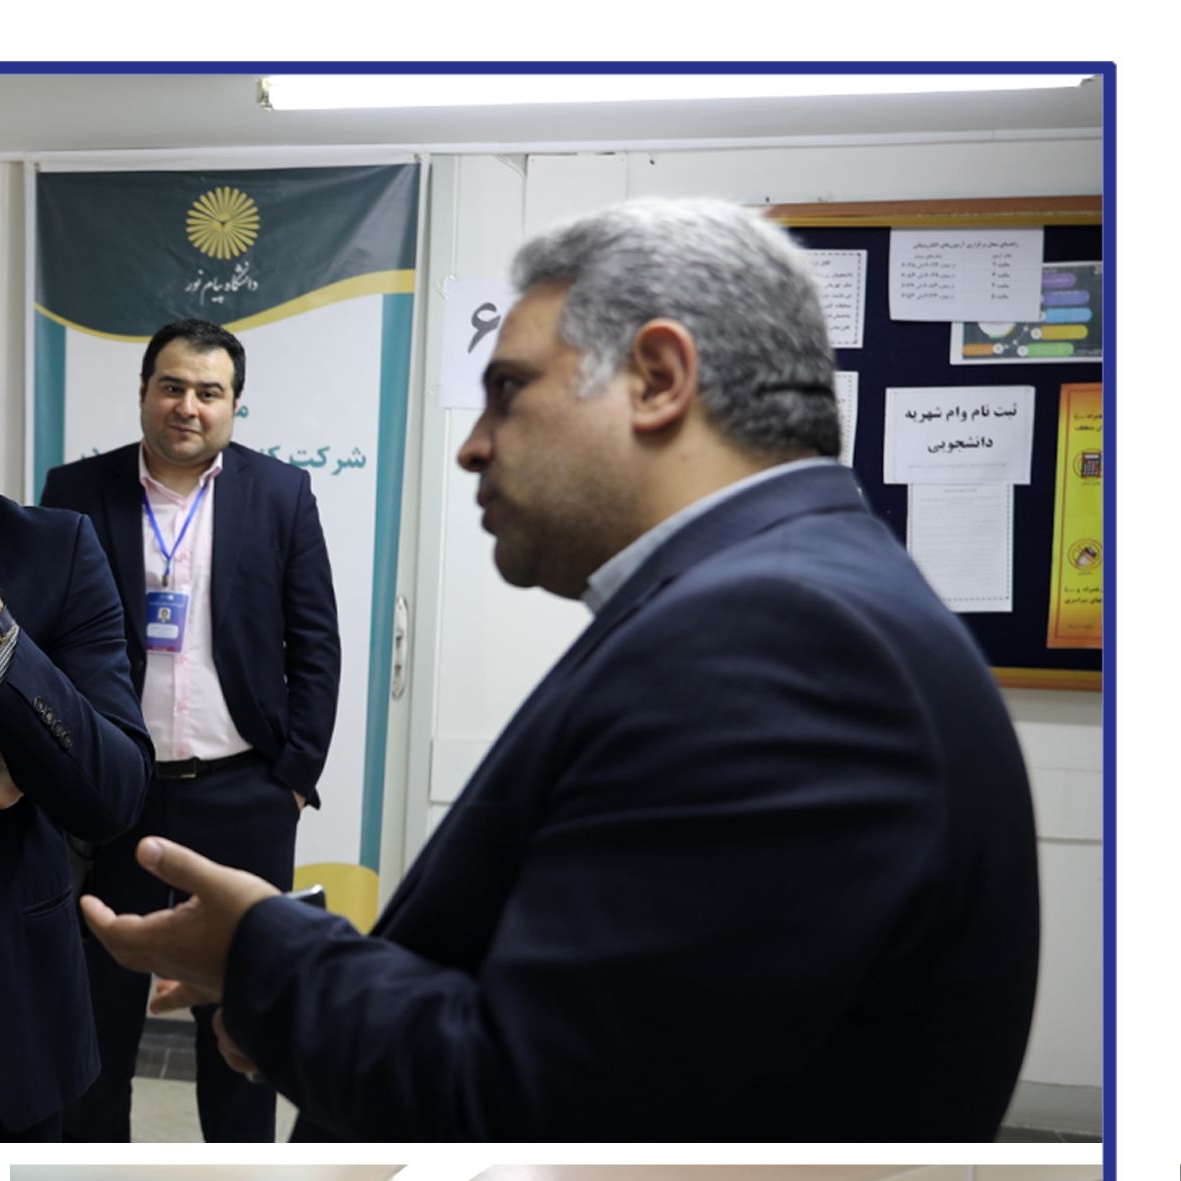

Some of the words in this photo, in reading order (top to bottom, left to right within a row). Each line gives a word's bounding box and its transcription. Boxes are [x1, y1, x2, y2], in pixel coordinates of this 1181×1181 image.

[184, 269, 202, 292] نور
[224, 261, 258, 292] دانشگاه
[200, 277, 224, 306] پیام
[905, 406, 942, 423] شهریه
[946, 406, 968, 422] وام
[971, 404, 990, 421] نام
[993, 402, 1018, 420] ثبت
[927, 436, 993, 454] دانشجویی
[289, 445, 366, 475] شرکت
